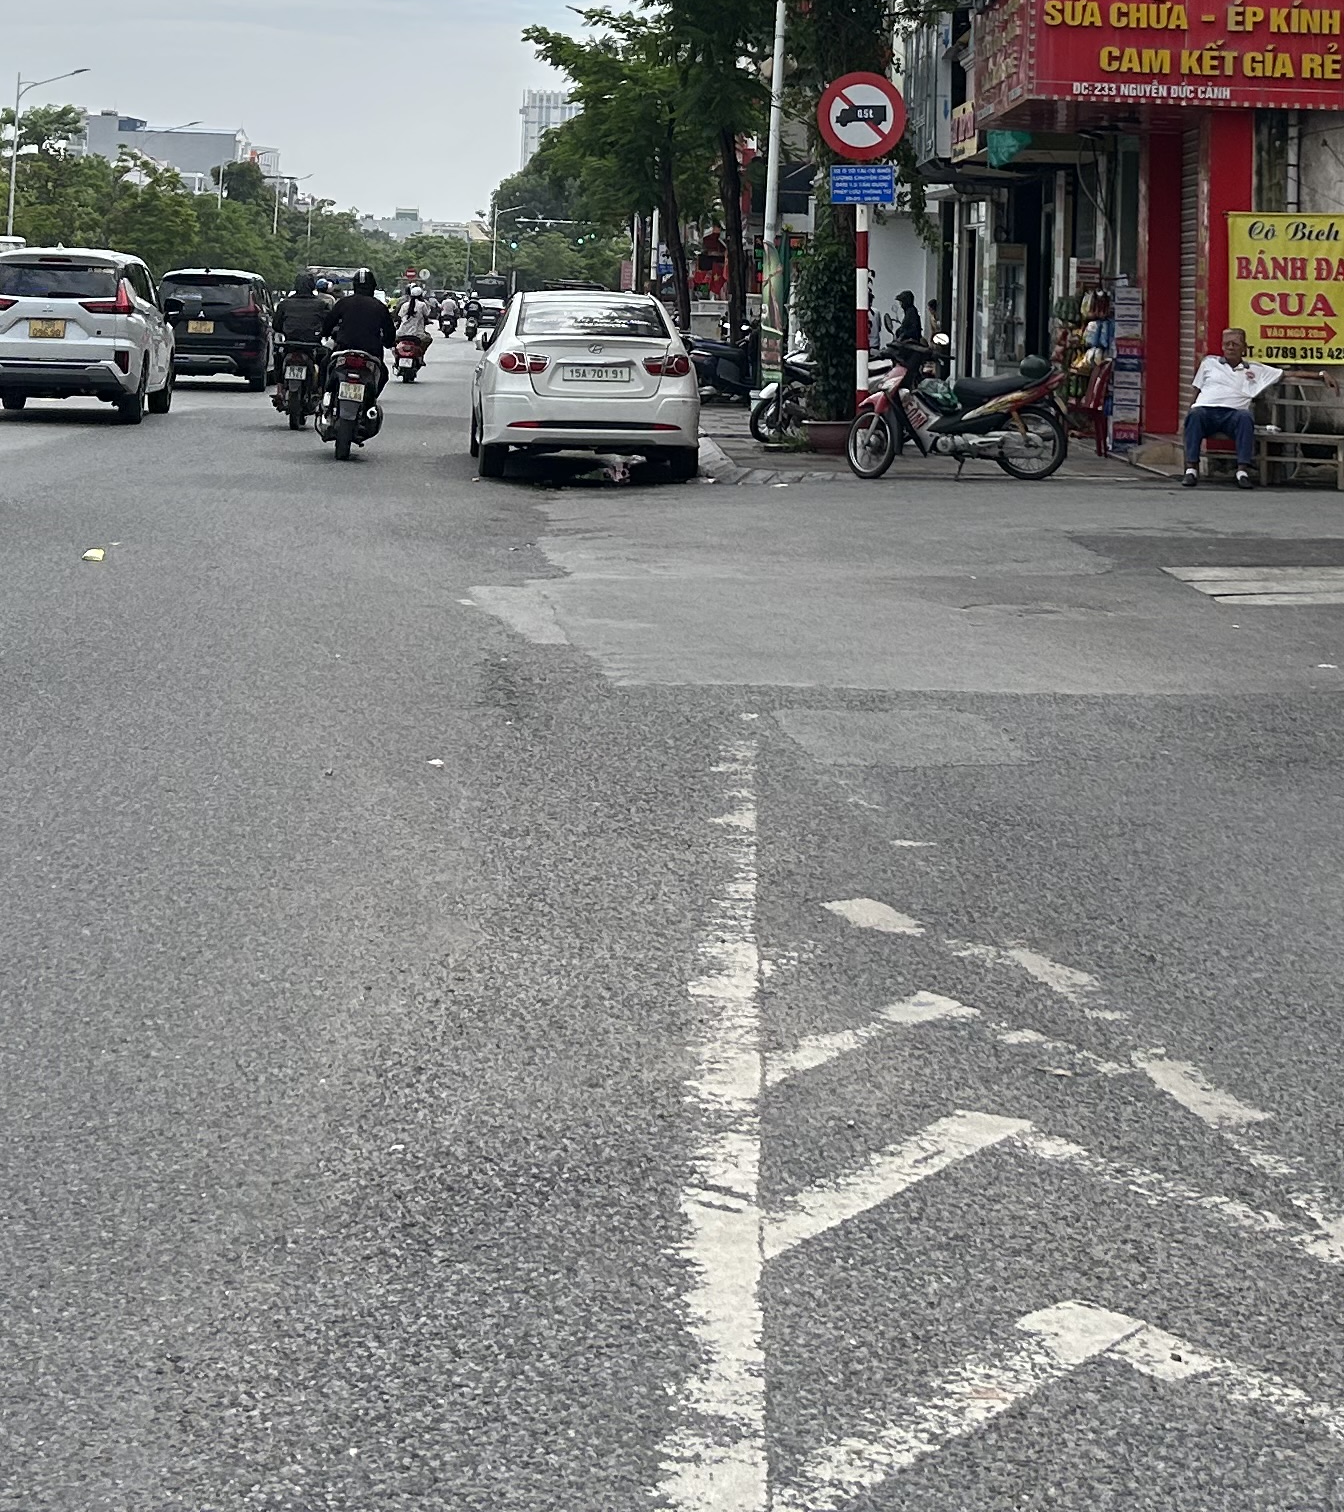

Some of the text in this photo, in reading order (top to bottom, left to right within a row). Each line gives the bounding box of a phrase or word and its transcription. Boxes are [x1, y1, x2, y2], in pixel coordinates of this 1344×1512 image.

[1227, 0, 1264, 33] ÉP
[1269, 0, 1341, 35] KÍNH
[1098, 45, 1171, 75] CAM
[1180, 41, 1238, 76] KẾT
[1302, 43, 1343, 81] RẺ
[1248, 220, 1340, 241] Cô Bích
[1236, 250, 1308, 281] BÁNH
[1250, 292, 1338, 317] CUA
[1266, 346, 1296, 359] 0789
[1300, 347, 1323, 360] 315
